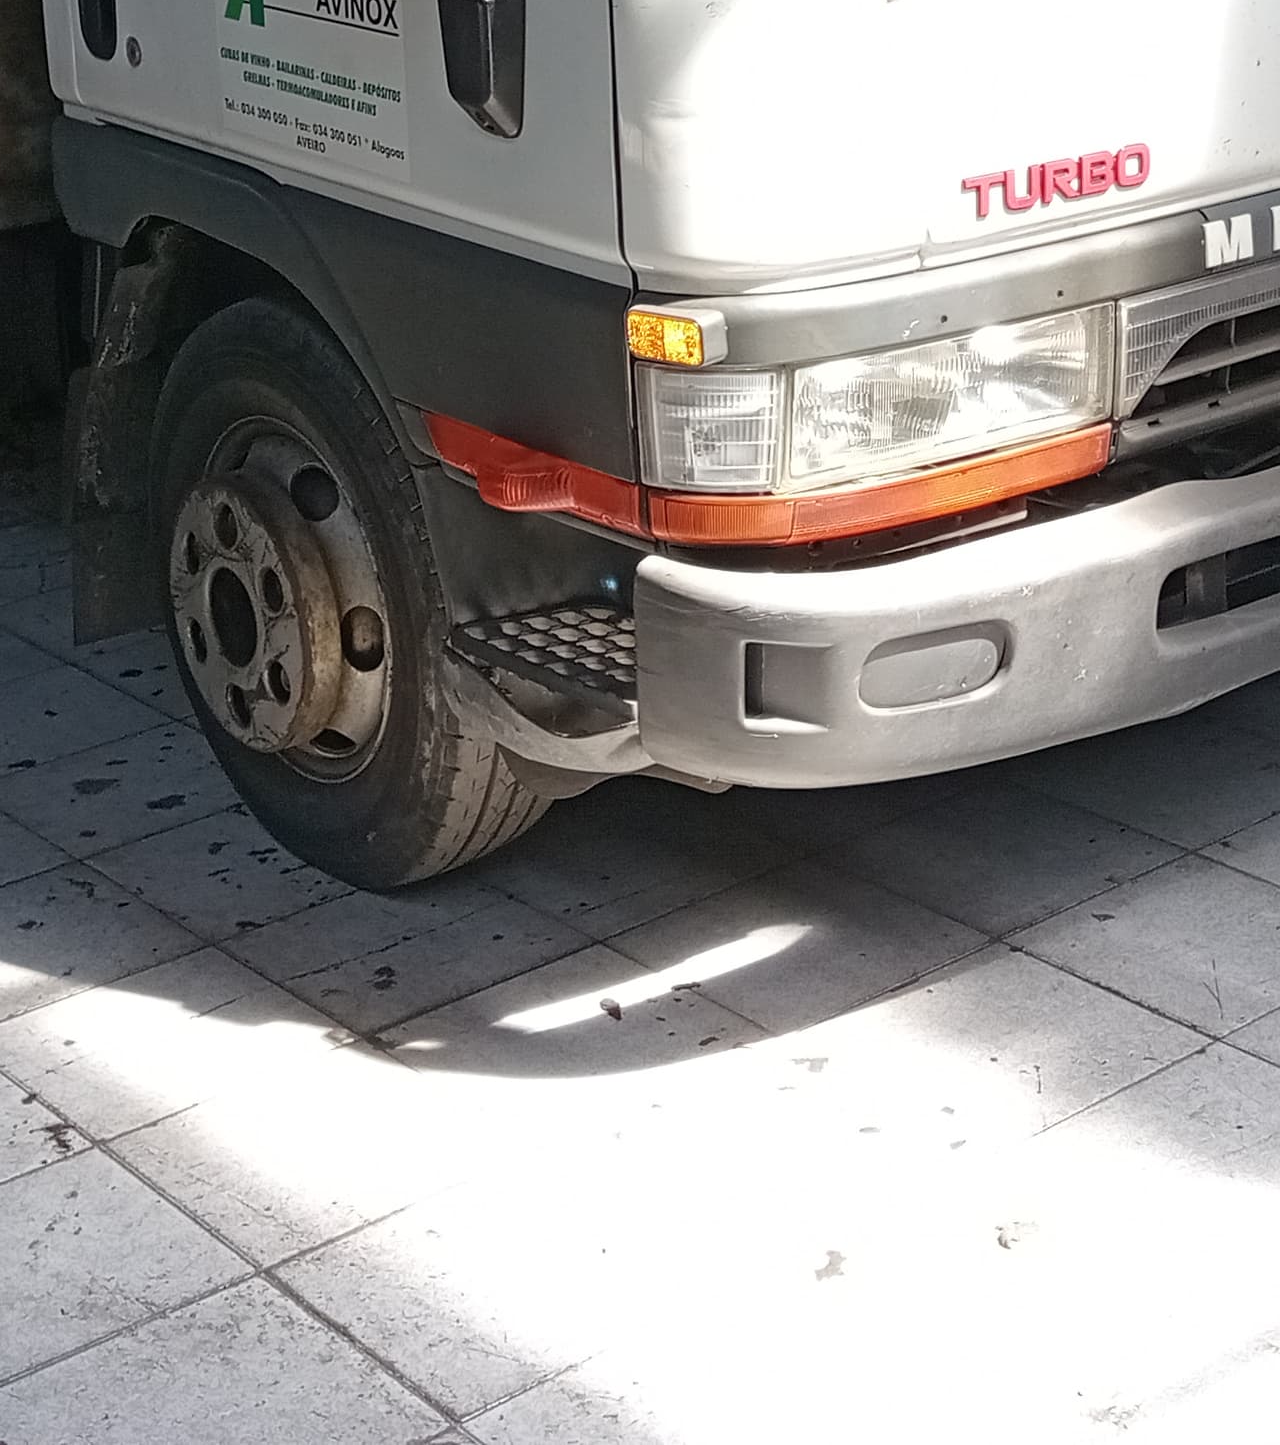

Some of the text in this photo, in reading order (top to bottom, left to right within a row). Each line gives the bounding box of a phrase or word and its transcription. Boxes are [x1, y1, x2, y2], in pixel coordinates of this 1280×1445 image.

[220, 47, 239, 61] CUBAS
[241, 50, 249, 63] DE
[250, 54, 270, 68] VINHO
[321, 71, 356, 90] CALDEIRAS
[363, 82, 401, 103] DEPÓSITOS
[241, 102, 255, 115] 034
[313, 123, 327, 136] 034
[330, 128, 345, 142] 300
[347, 132, 362, 146] 051
[357, 101, 376, 116] AFINS
[296, 135, 326, 153] AVEIRO
[962, 142, 1150, 218] TURBO
